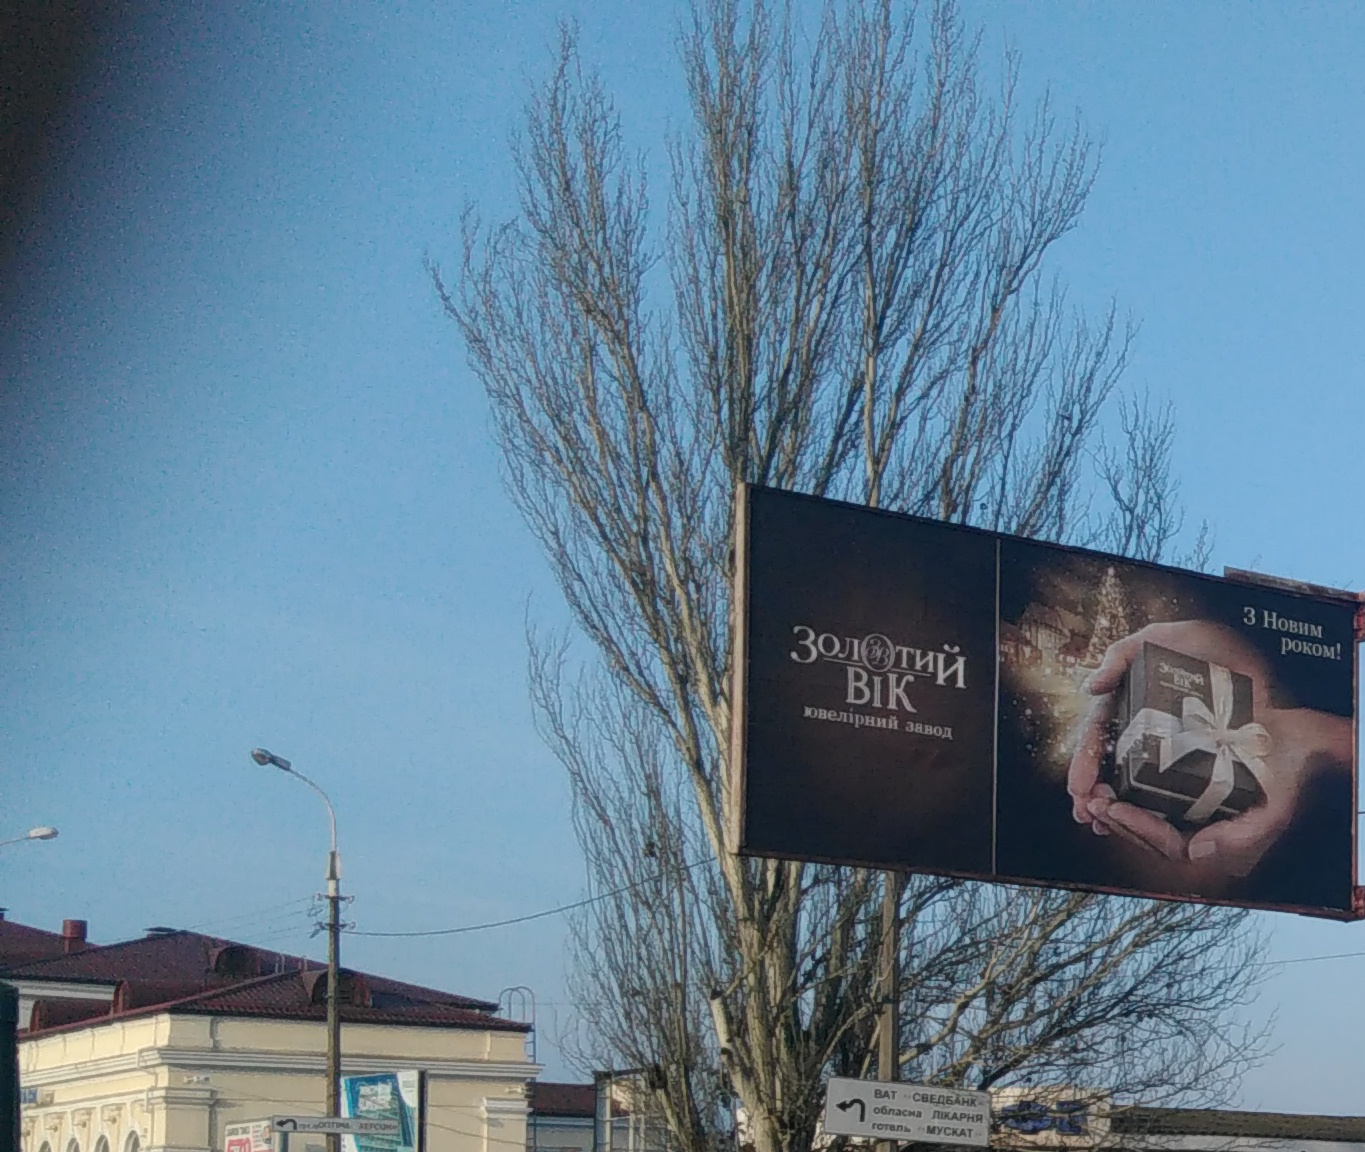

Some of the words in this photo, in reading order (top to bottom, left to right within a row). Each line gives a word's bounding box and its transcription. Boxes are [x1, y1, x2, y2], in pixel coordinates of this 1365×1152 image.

[1242, 606, 1256, 625] З
[1263, 609, 1324, 638] Новим
[1281, 636, 1342, 661] роком!
[845, 666, 918, 713] ВІК
[803, 705, 900, 731] ювелірний
[905, 720, 954, 740] завод
[874, 1088, 898, 1100] ВАТ
[873, 1105, 923, 1119] обласна
[931, 1109, 984, 1124] ЛІКАРНЯ
[871, 1121, 912, 1134] готель
